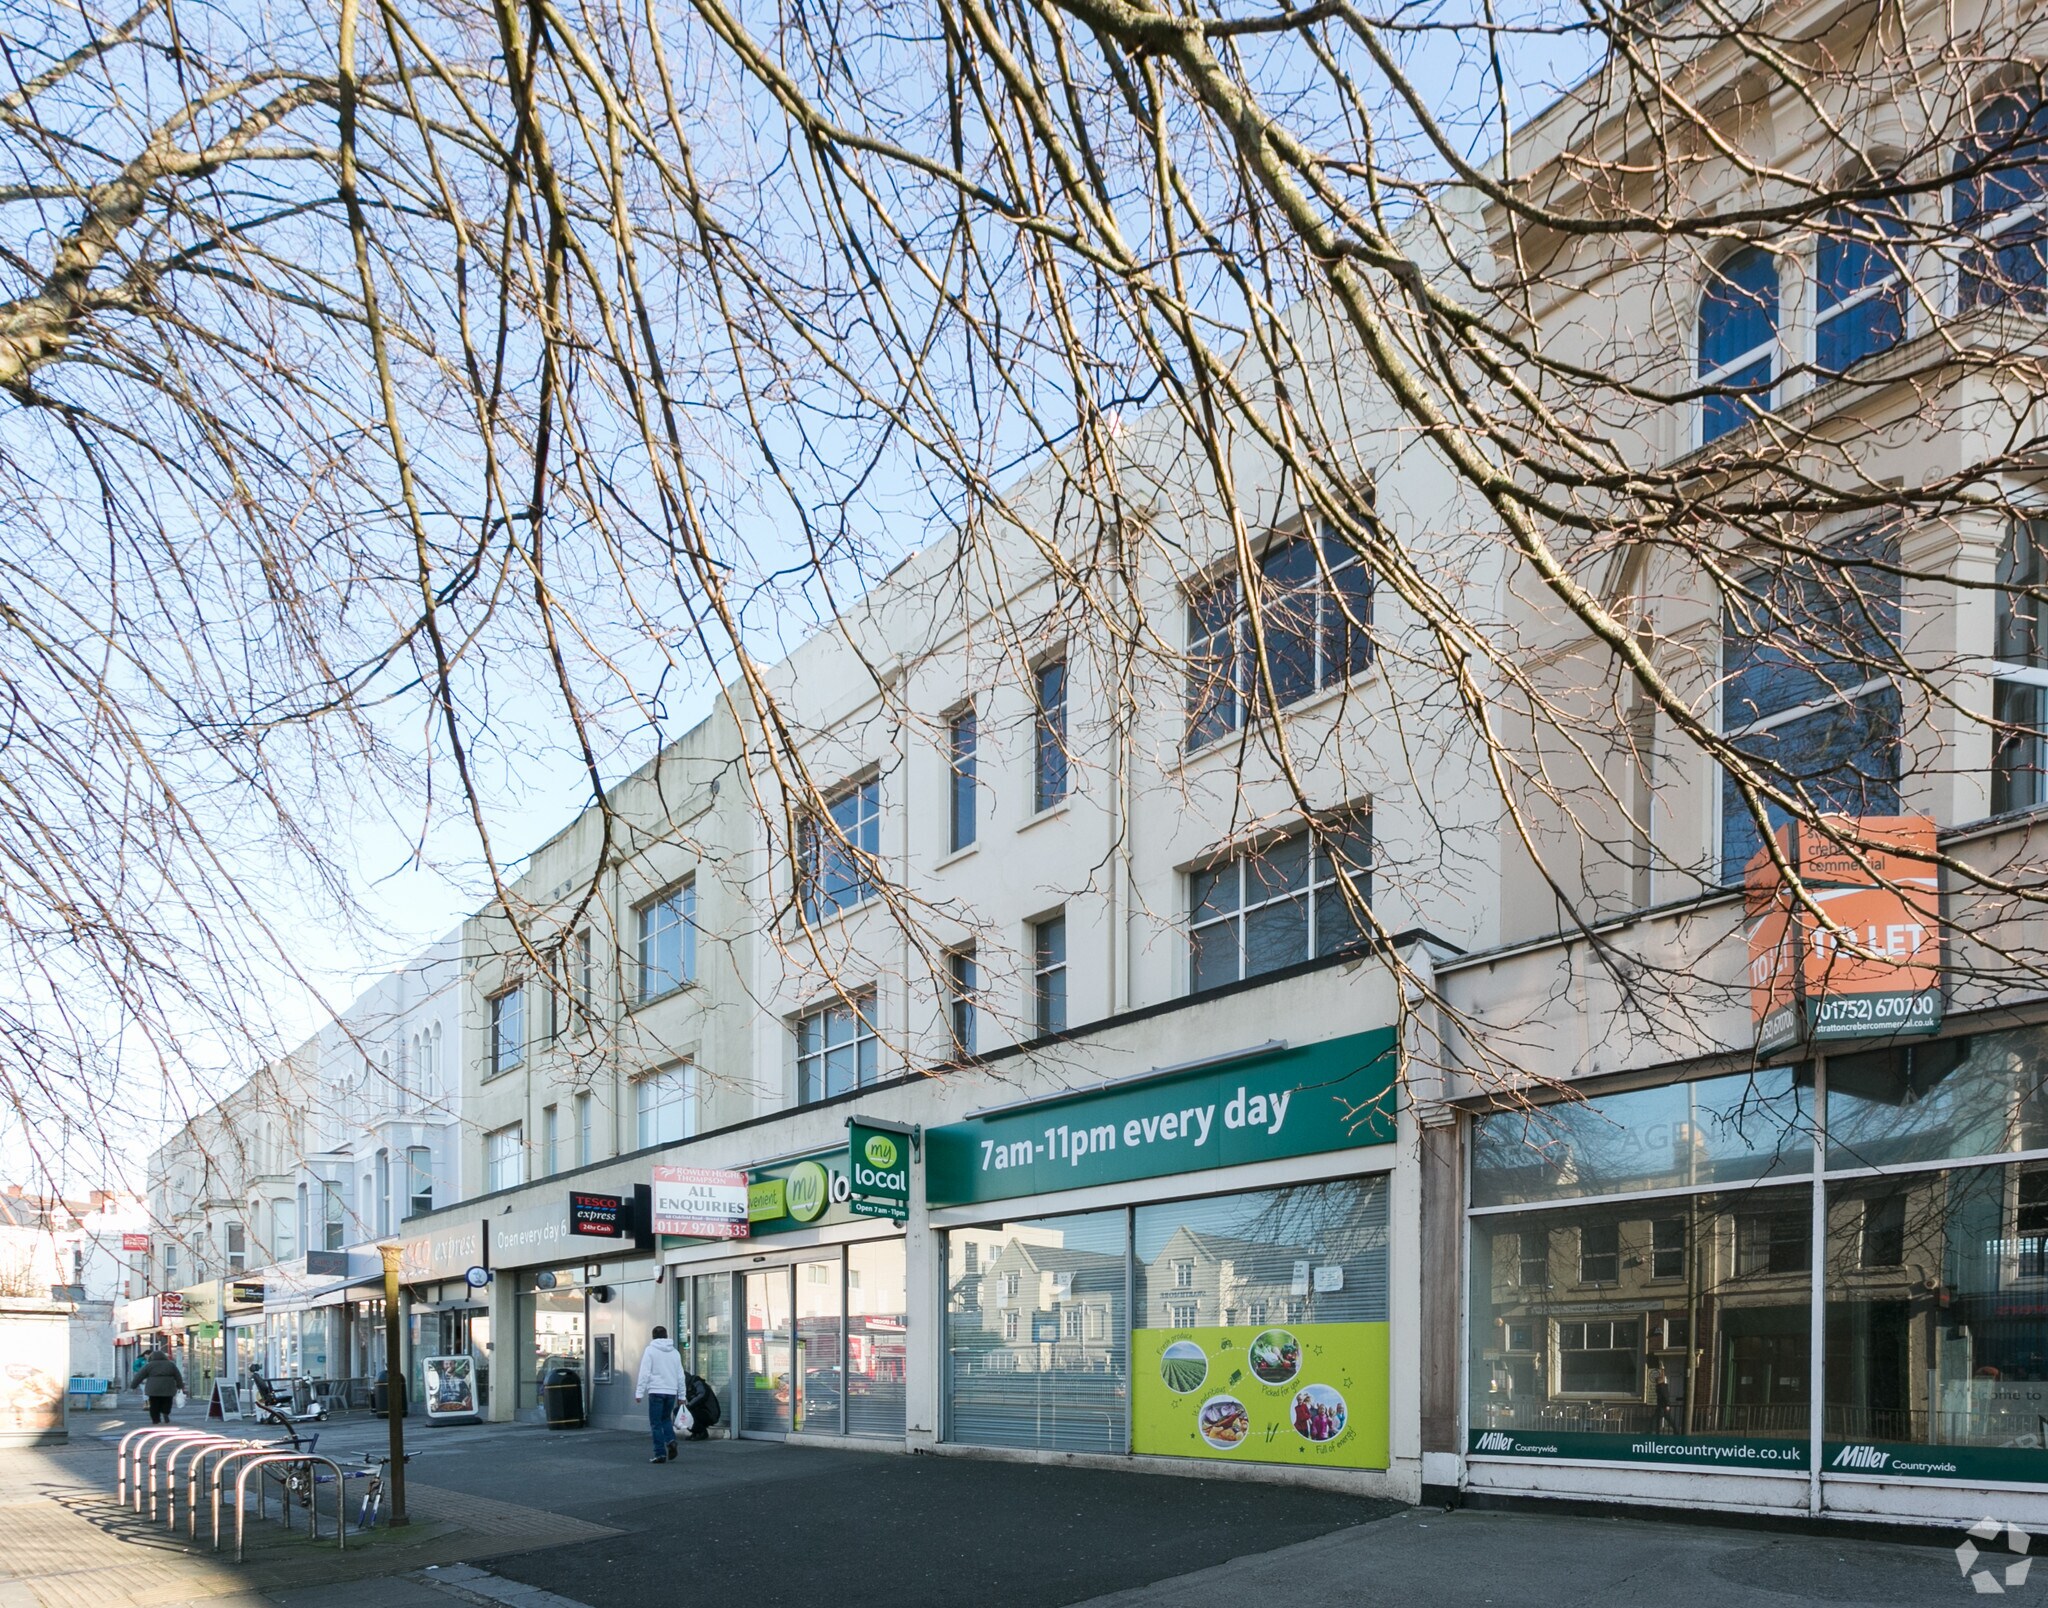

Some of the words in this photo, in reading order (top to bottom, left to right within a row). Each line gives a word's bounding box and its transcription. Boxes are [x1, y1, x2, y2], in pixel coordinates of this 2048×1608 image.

[1808, 855, 1886, 872] commeial
[1810, 925, 1858, 959] TO
[1868, 923, 1926, 957] LET
[1751, 955, 1768, 987] TO
[1815, 999, 1873, 1024] (01752)
[1875, 996, 1934, 1018] 670700
[980, 1124, 1116, 1171] 7am-11pm
[1123, 1104, 1215, 1147] every
[1224, 1087, 1292, 1135] day
[870, 1142, 893, 1164] my
[676, 1167, 711, 1178] ROWLEY
[677, 1175, 727, 1185] THOMPSON
[855, 1163, 907, 1191] local
[688, 1185, 717, 1198] ALL
[792, 1174, 817, 1212] my
[575, 1196, 617, 1208] TESCO
[659, 1198, 745, 1214] ENQUIRIES
[855, 1203, 873, 1213] Open
[577, 1210, 616, 1221] express
[583, 1223, 596, 1231] 24hr
[596, 1224, 611, 1232] Cash
[657, 1220, 688, 1233] 0117
[691, 1222, 715, 1234] 970
[717, 1224, 747, 1236] 7535
[497, 1231, 519, 1251] Open
[519, 1229, 543, 1246] every
[543, 1222, 560, 1241] day
[400, 1239, 430, 1266] SCO
[434, 1234, 476, 1268] express
[1156, 1339, 1170, 1355] Fresh
[1170, 1333, 1193, 1343] produce
[1261, 1384, 1280, 1397] Picked
[1280, 1386, 1289, 1397] for
[1290, 1379, 1300, 1393] you
[2026, 1390, 2042, 1401] to
[1315, 1445, 1328, 1454] Full
[1328, 1441, 1336, 1453] of
[1475, 1432, 1515, 1451] Miller
[1515, 1443, 1558, 1454] Countrywide
[1632, 1442, 1801, 1461] millercountrywide.co.uk
[1832, 1445, 1891, 1469] Miller
[1891, 1459, 1957, 1474] Countrywide
